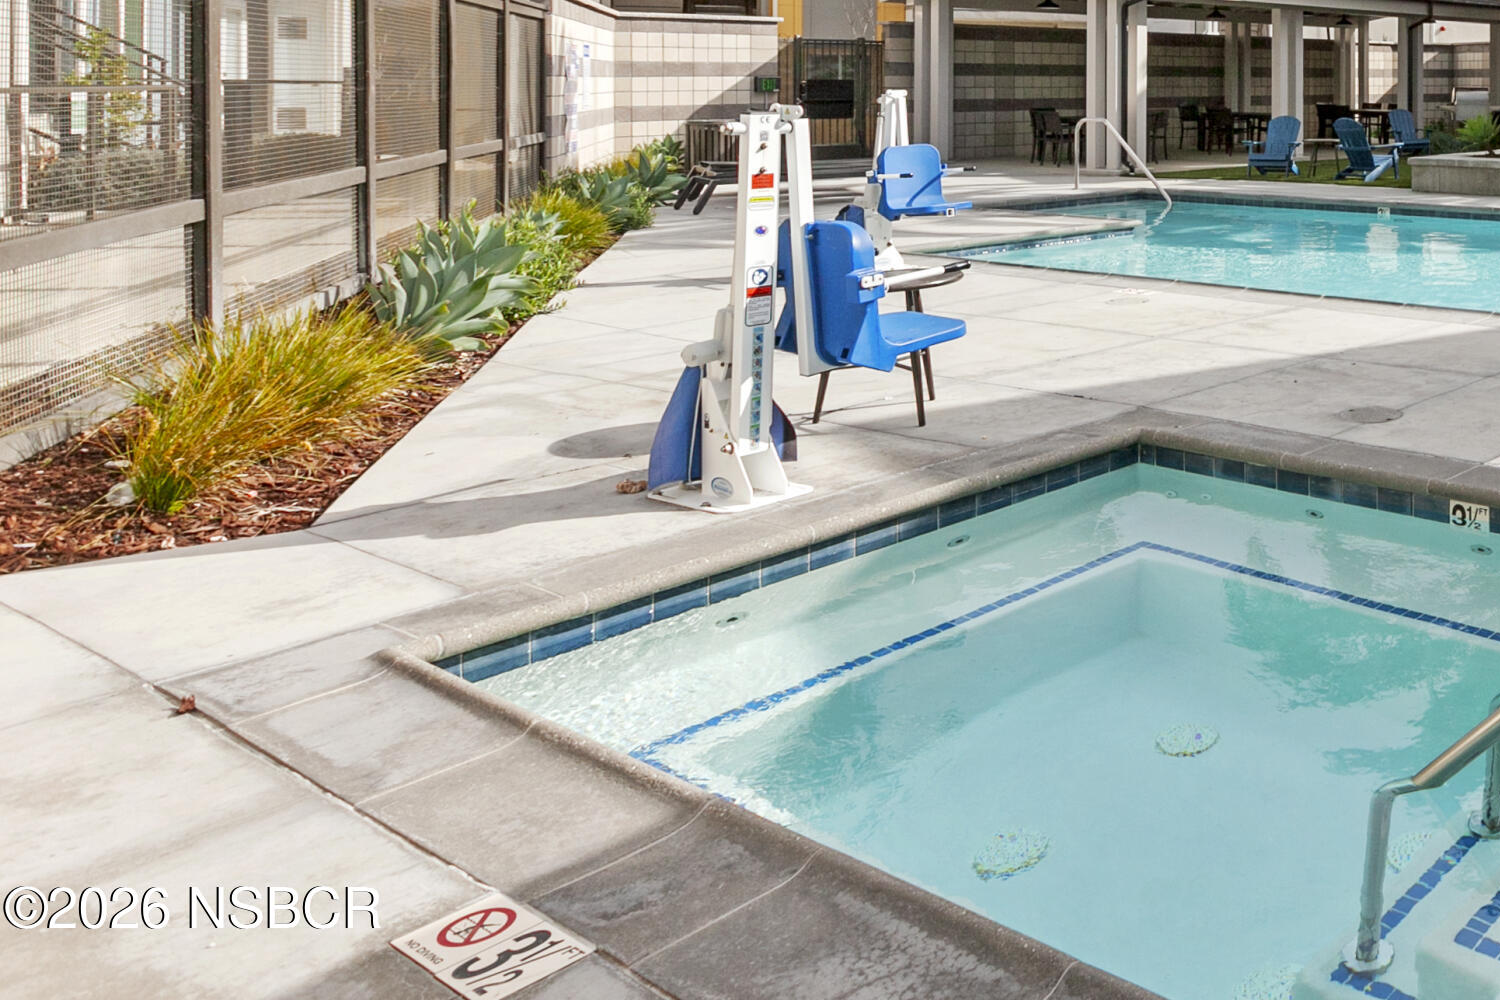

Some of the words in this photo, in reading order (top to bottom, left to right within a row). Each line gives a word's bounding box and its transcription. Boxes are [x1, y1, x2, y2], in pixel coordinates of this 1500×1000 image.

[407, 939, 421, 949] NO
[416, 946, 444, 965] DIVING
[561, 946, 585, 959] FT
